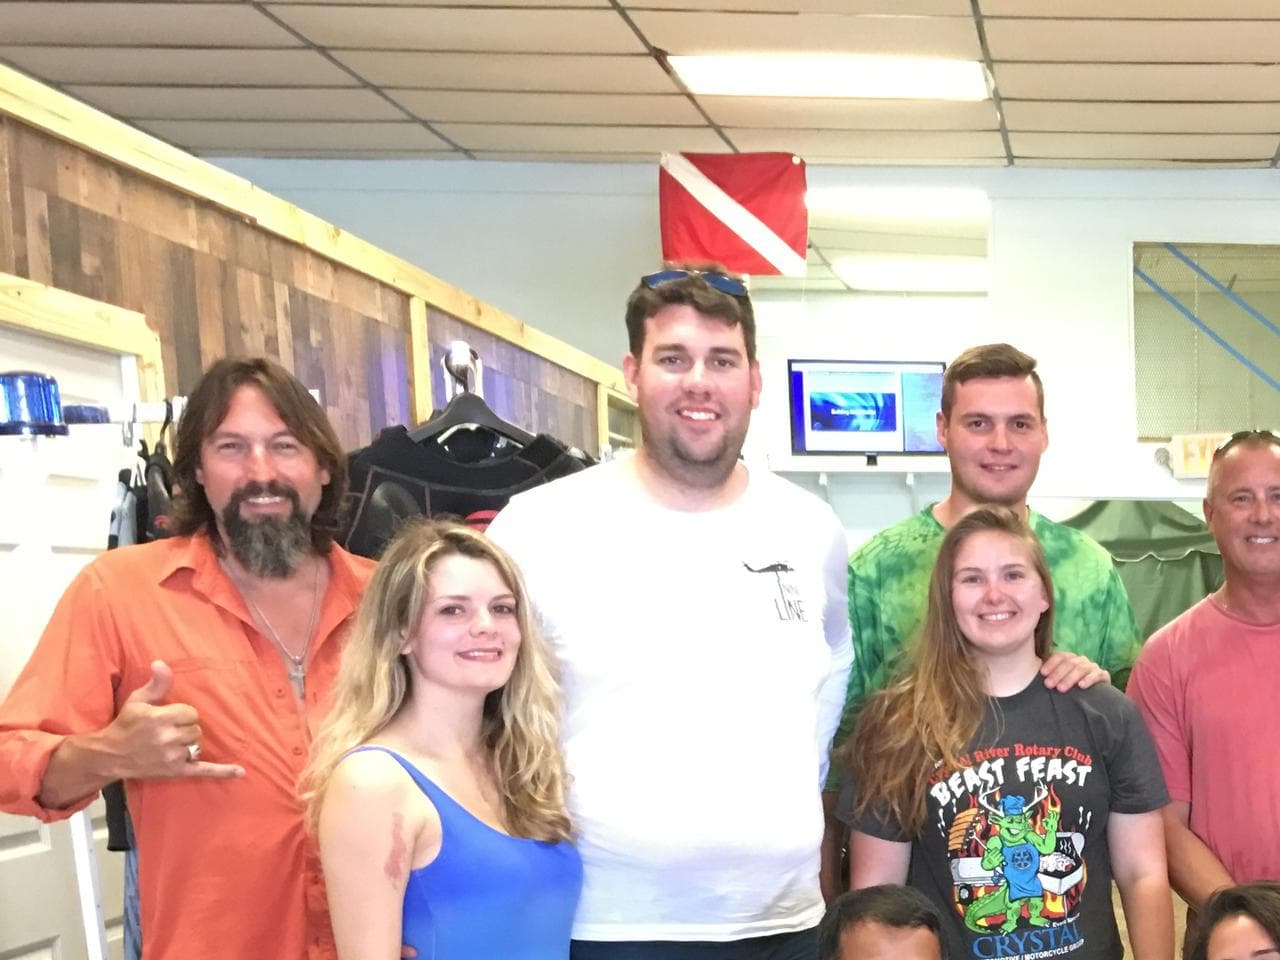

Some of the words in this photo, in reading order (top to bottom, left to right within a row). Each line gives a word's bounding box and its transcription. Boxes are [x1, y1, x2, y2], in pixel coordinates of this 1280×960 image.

[974, 747, 1010, 763] River
[1014, 743, 1061, 758] Rotary
[1064, 745, 1092, 766] Club
[930, 758, 1005, 807] BEAST
[1016, 756, 1092, 787] FEAST
[1024, 946, 1068, 960] MOTORCYCLE
